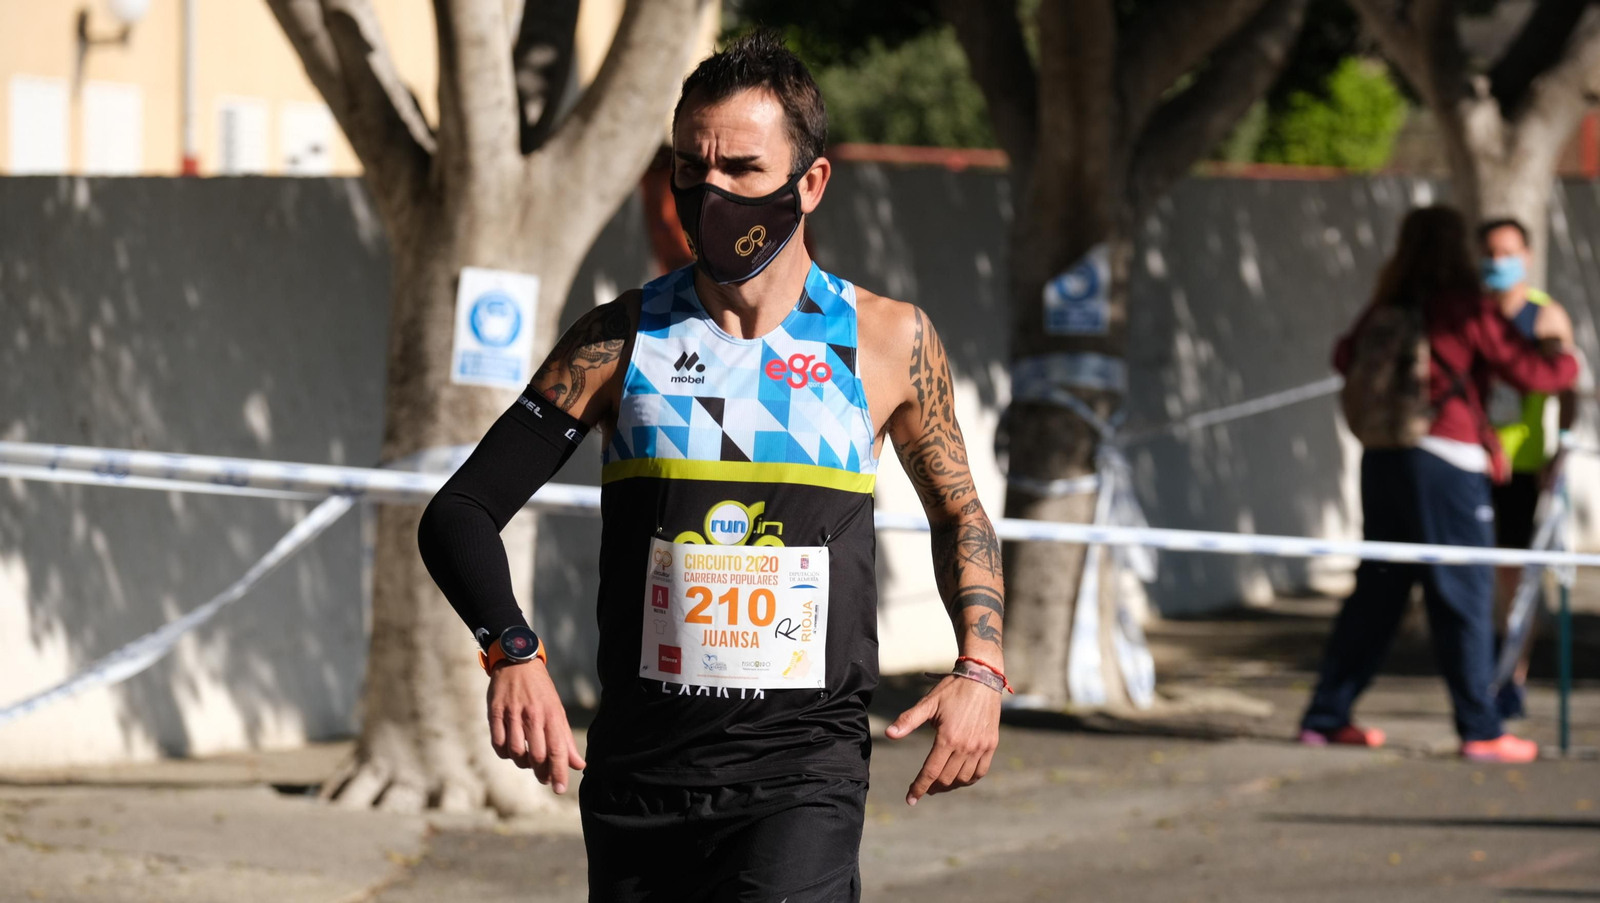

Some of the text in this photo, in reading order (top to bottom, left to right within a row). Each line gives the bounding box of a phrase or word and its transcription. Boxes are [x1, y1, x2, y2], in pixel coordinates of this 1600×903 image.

[671, 376, 705, 384] mobel
[765, 353, 833, 389] ego
[711, 520, 746, 533] run
[684, 553, 779, 574] CIRCUITO 2020
[684, 571, 728, 584] CARRERAS
[730, 574, 779, 586] POPULARES
[656, 589, 663, 605] A
[684, 585, 776, 627] 210
[801, 600, 813, 642] RIOJA
[701, 629, 760, 649] JUANSA
